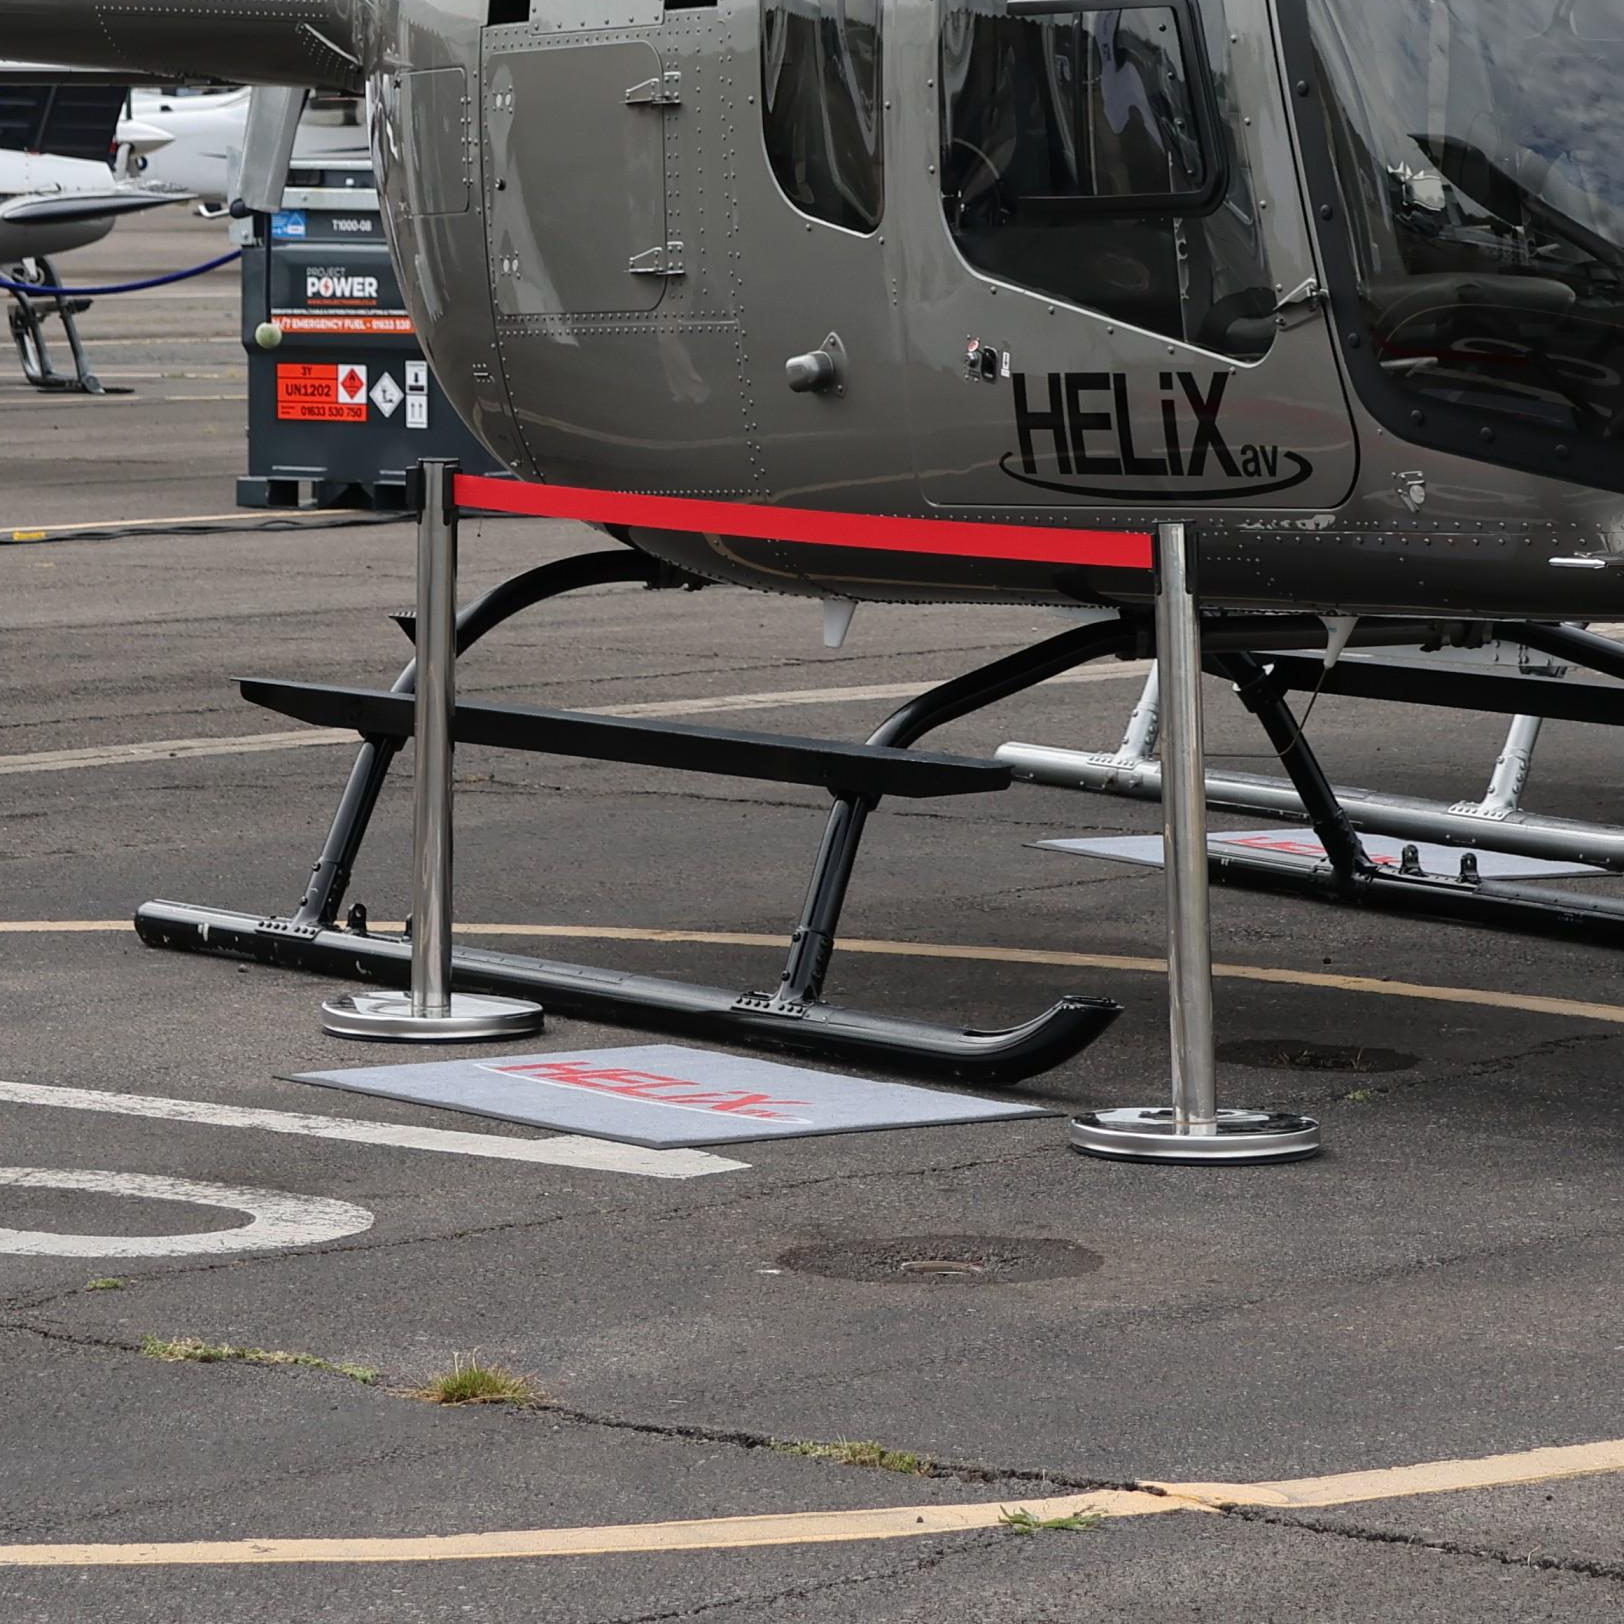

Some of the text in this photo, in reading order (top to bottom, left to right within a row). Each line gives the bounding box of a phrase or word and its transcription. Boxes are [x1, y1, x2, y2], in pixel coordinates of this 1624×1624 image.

[306, 267, 346, 277] PROJECT
[306, 277, 378, 297] POWER
[285, 384, 331, 397] UN1202
